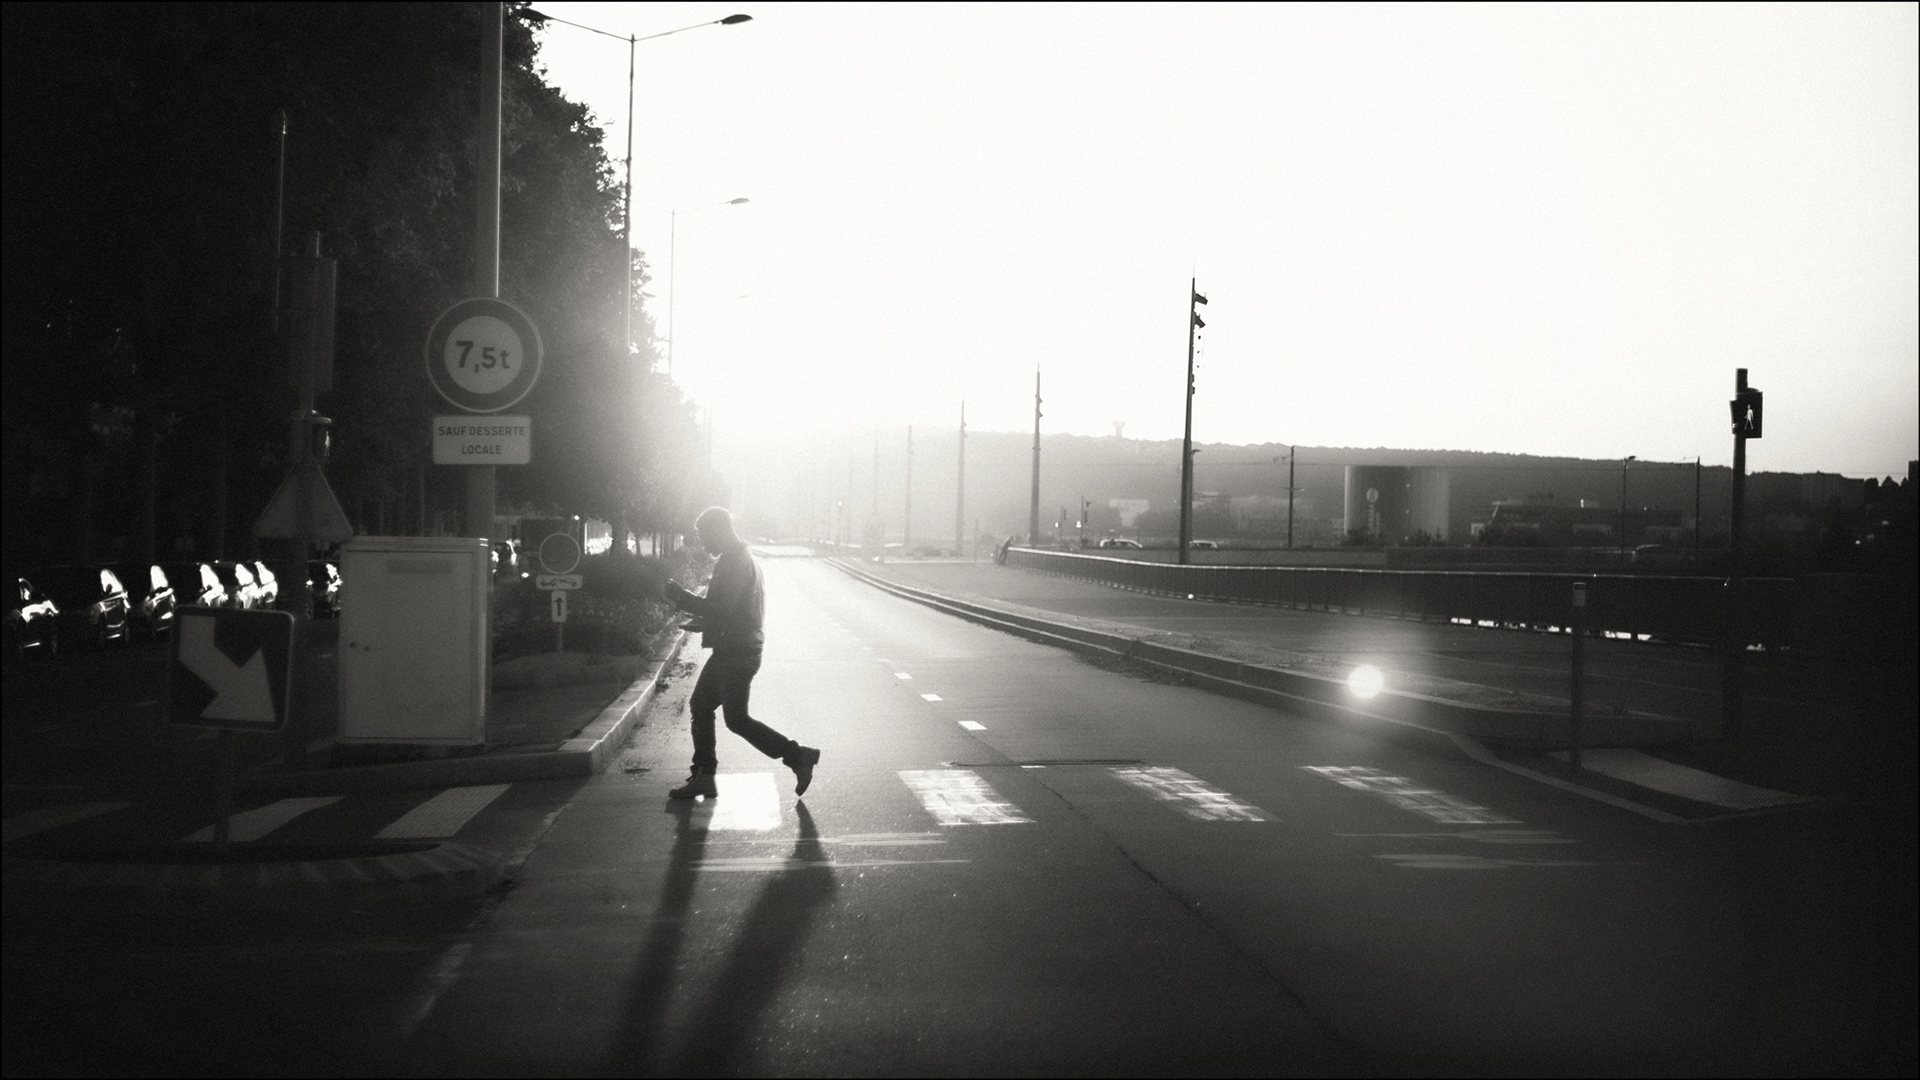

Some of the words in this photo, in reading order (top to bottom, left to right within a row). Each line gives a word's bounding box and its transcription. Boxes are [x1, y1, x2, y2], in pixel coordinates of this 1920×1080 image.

[438, 426, 467, 436] SAUF
[469, 426, 525, 436] DESSERTE
[461, 445, 502, 455] LOCALE
